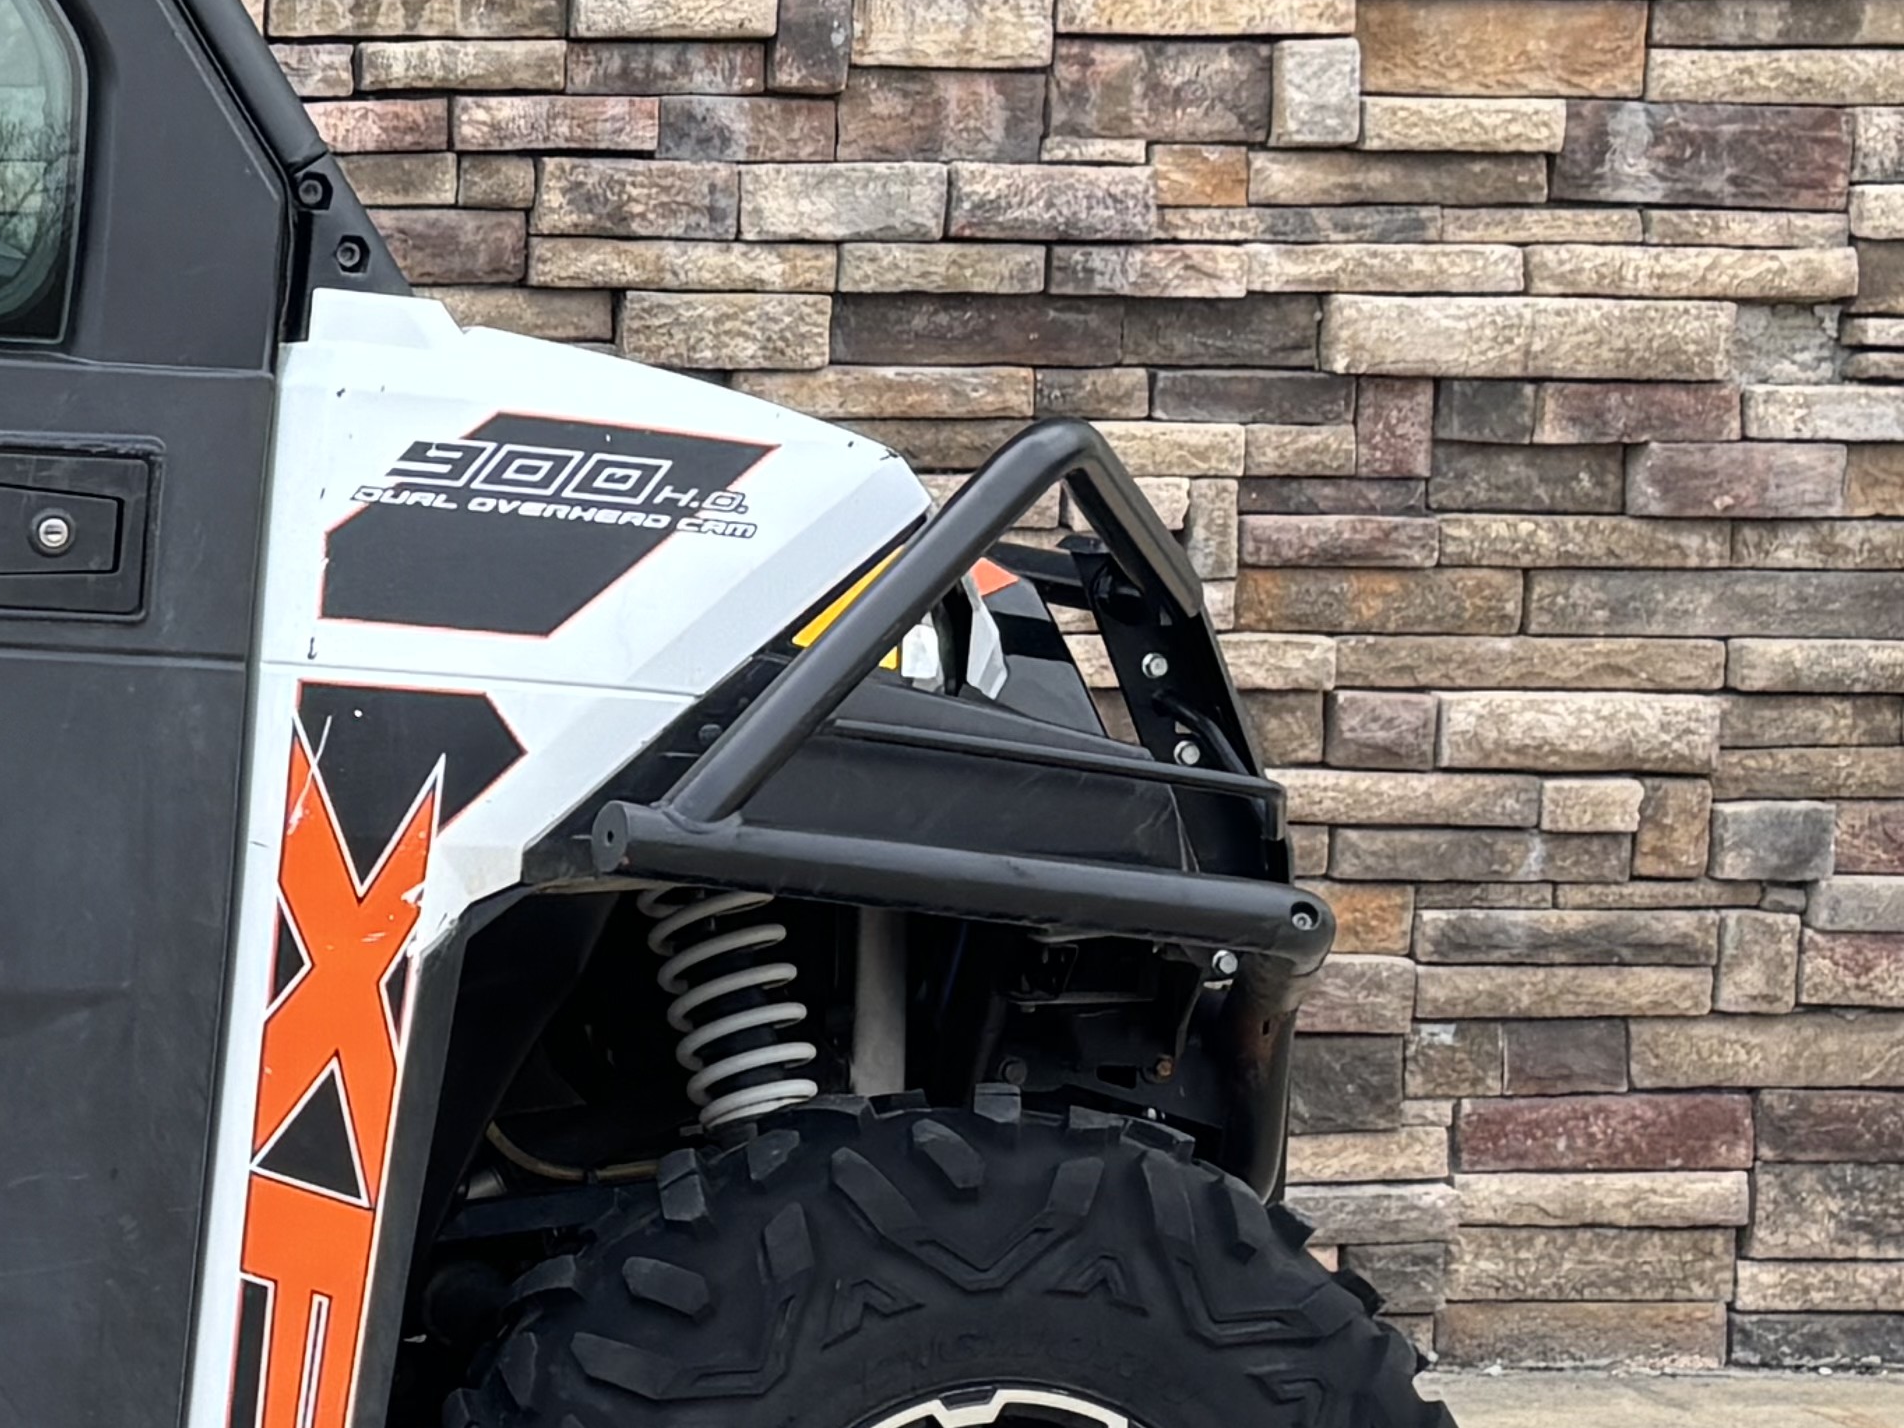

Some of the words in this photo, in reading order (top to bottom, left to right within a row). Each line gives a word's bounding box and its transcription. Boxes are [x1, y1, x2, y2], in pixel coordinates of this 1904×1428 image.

[384, 439, 673, 505] 900
[349, 484, 459, 510] DUAL
[467, 496, 672, 529] OVERHEAD
[674, 516, 758, 539] CAM
